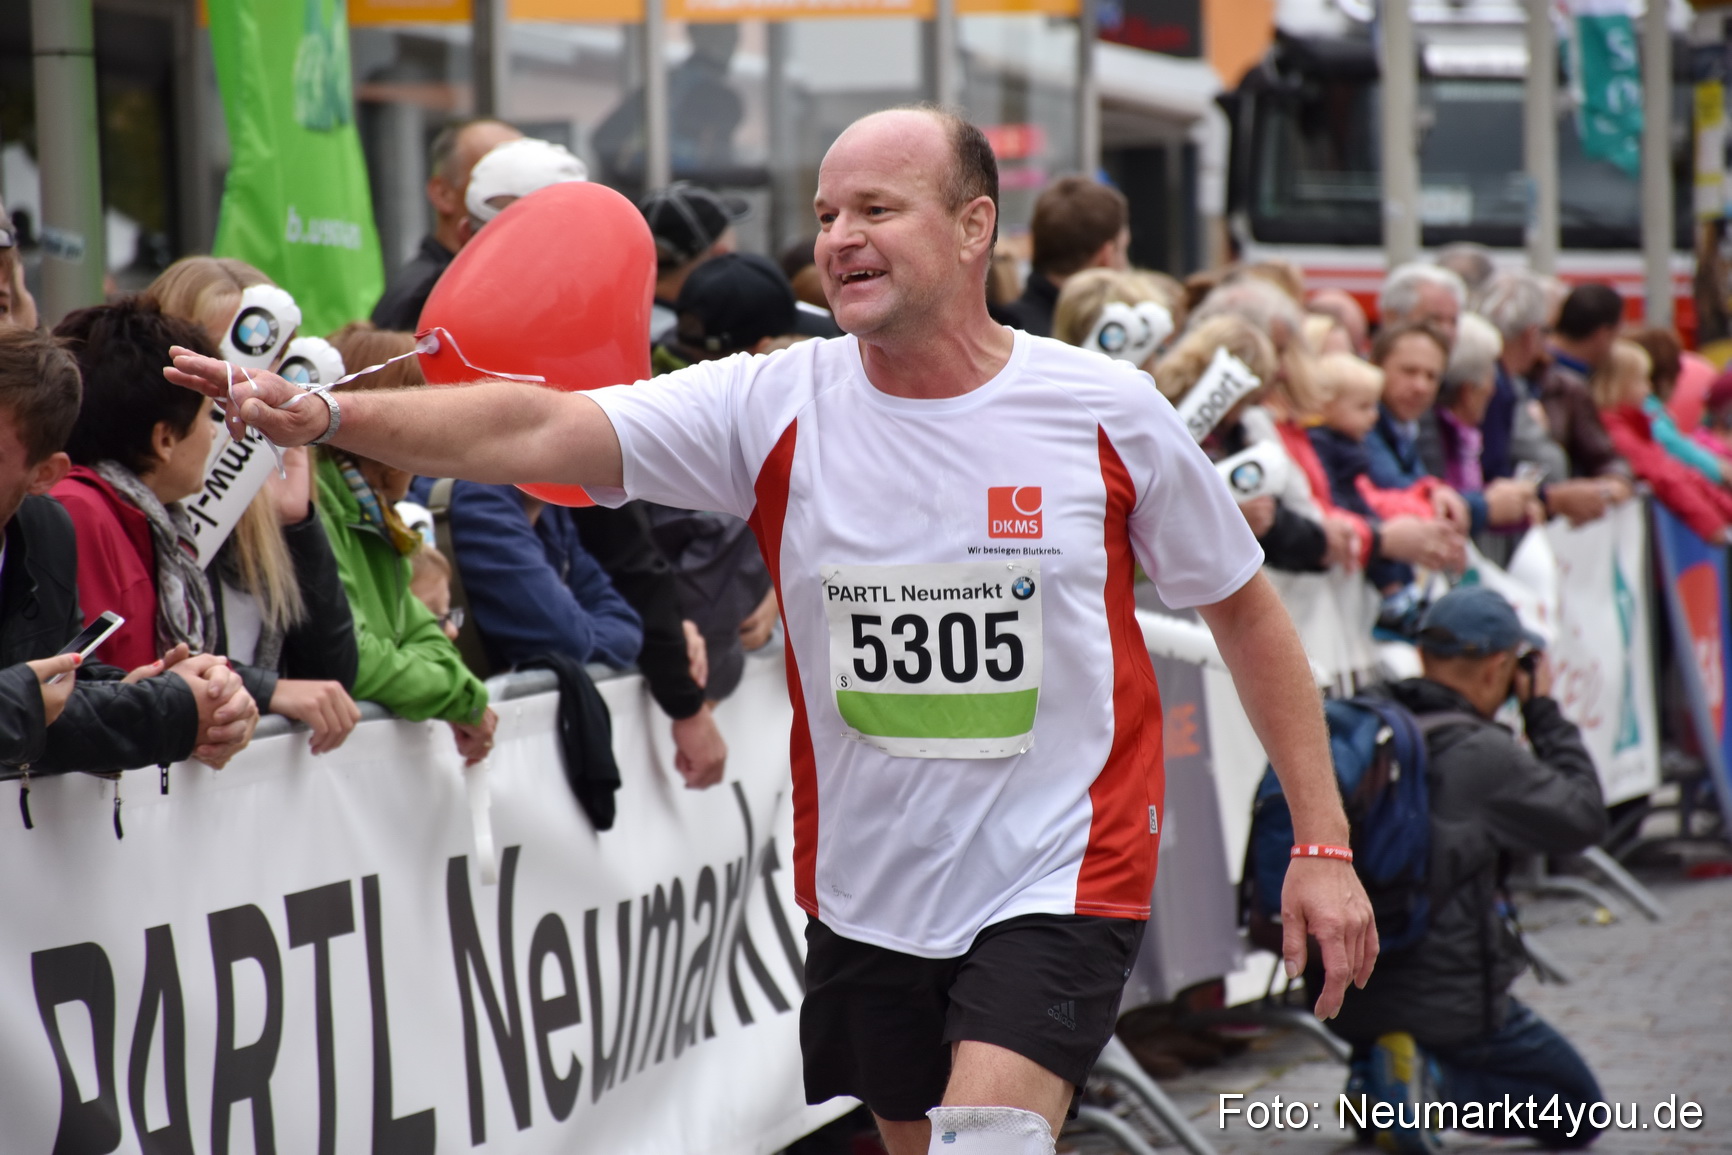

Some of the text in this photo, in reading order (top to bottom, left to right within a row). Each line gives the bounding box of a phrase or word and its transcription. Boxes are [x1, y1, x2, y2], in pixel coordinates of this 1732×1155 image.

[993, 520, 1038, 534] DKMS
[967, 546, 1063, 556] Wir besiegen Blutkrebs.
[827, 583, 1003, 602] PARTL Neumarkt
[851, 610, 1024, 684] 5305
[840, 675, 848, 688] S
[31, 781, 806, 1155] PARTL Neumarkt
[1047, 1008, 1077, 1031] adidas
